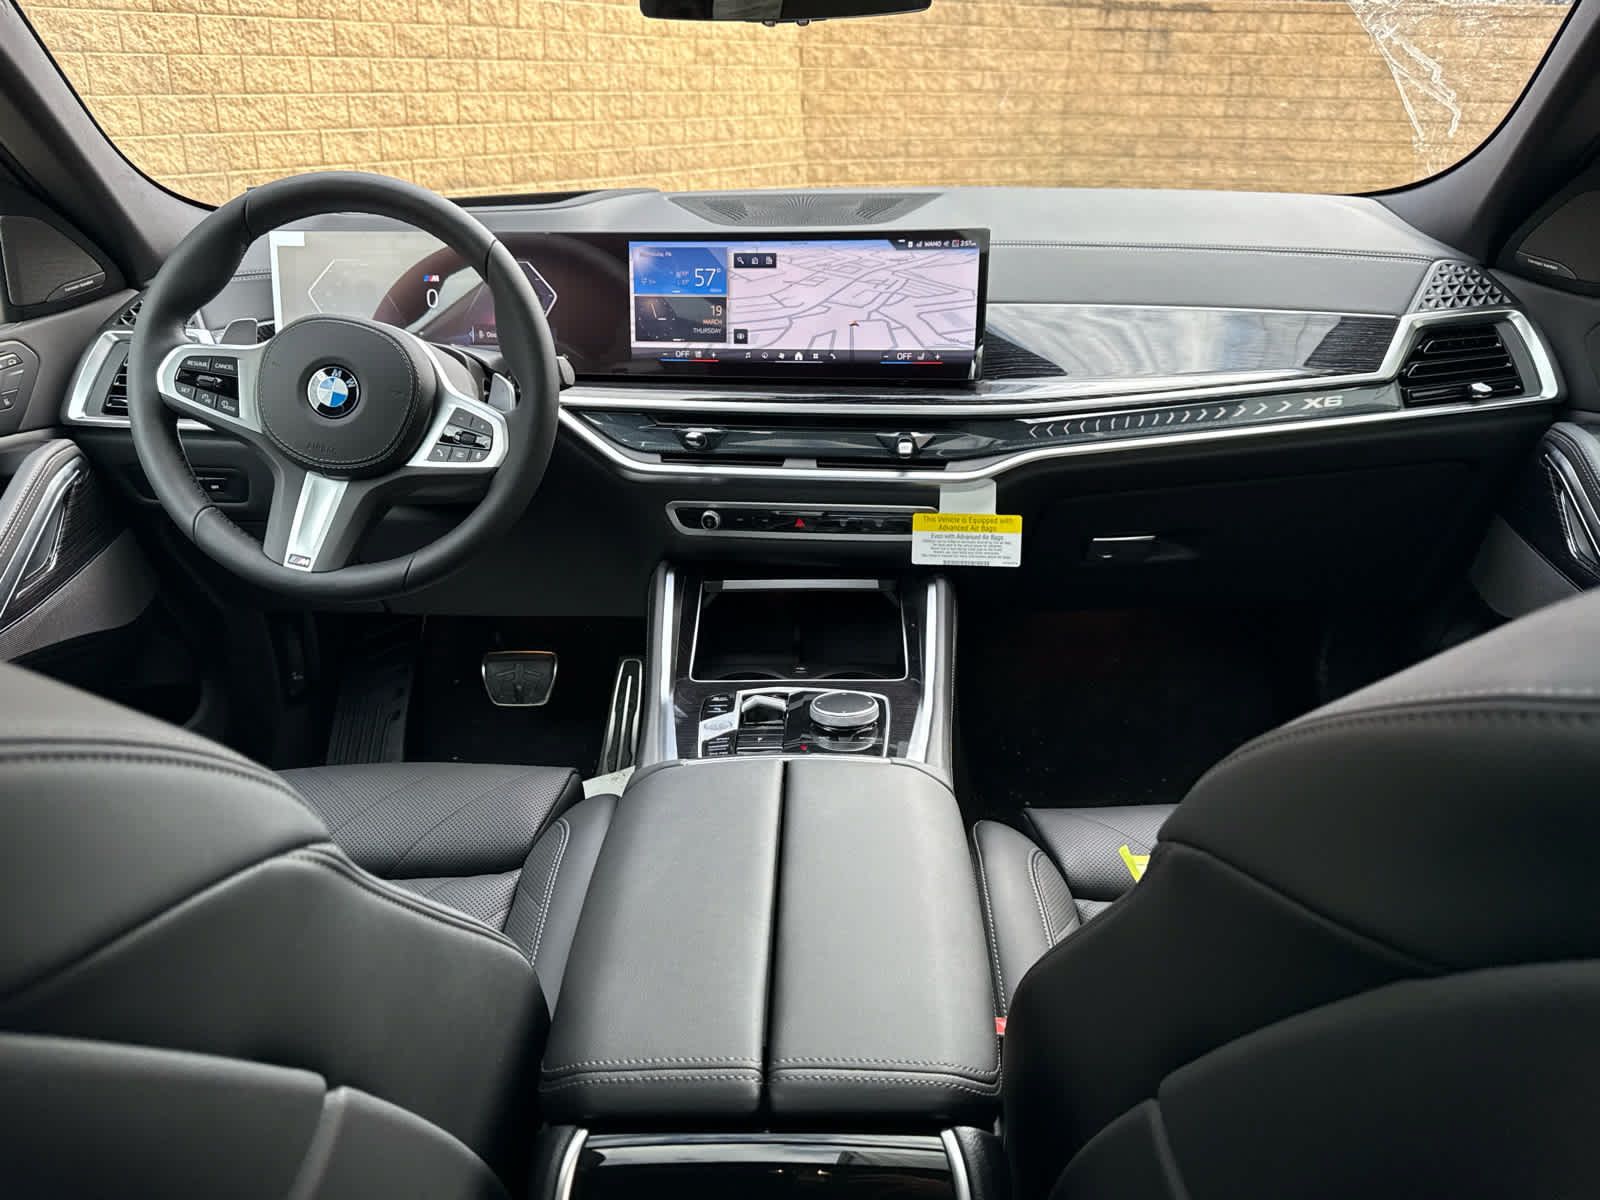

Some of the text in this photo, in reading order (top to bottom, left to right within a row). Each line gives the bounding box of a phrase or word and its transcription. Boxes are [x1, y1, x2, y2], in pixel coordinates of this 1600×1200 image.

[426, 288, 439, 308] 0
[711, 305, 722, 317] 19
[674, 350, 690, 358] OFF
[896, 352, 912, 360] OFF
[214, 363, 234, 371] CANCEL
[1300, 395, 1344, 410] X6
[968, 517, 998, 525] Equipped
